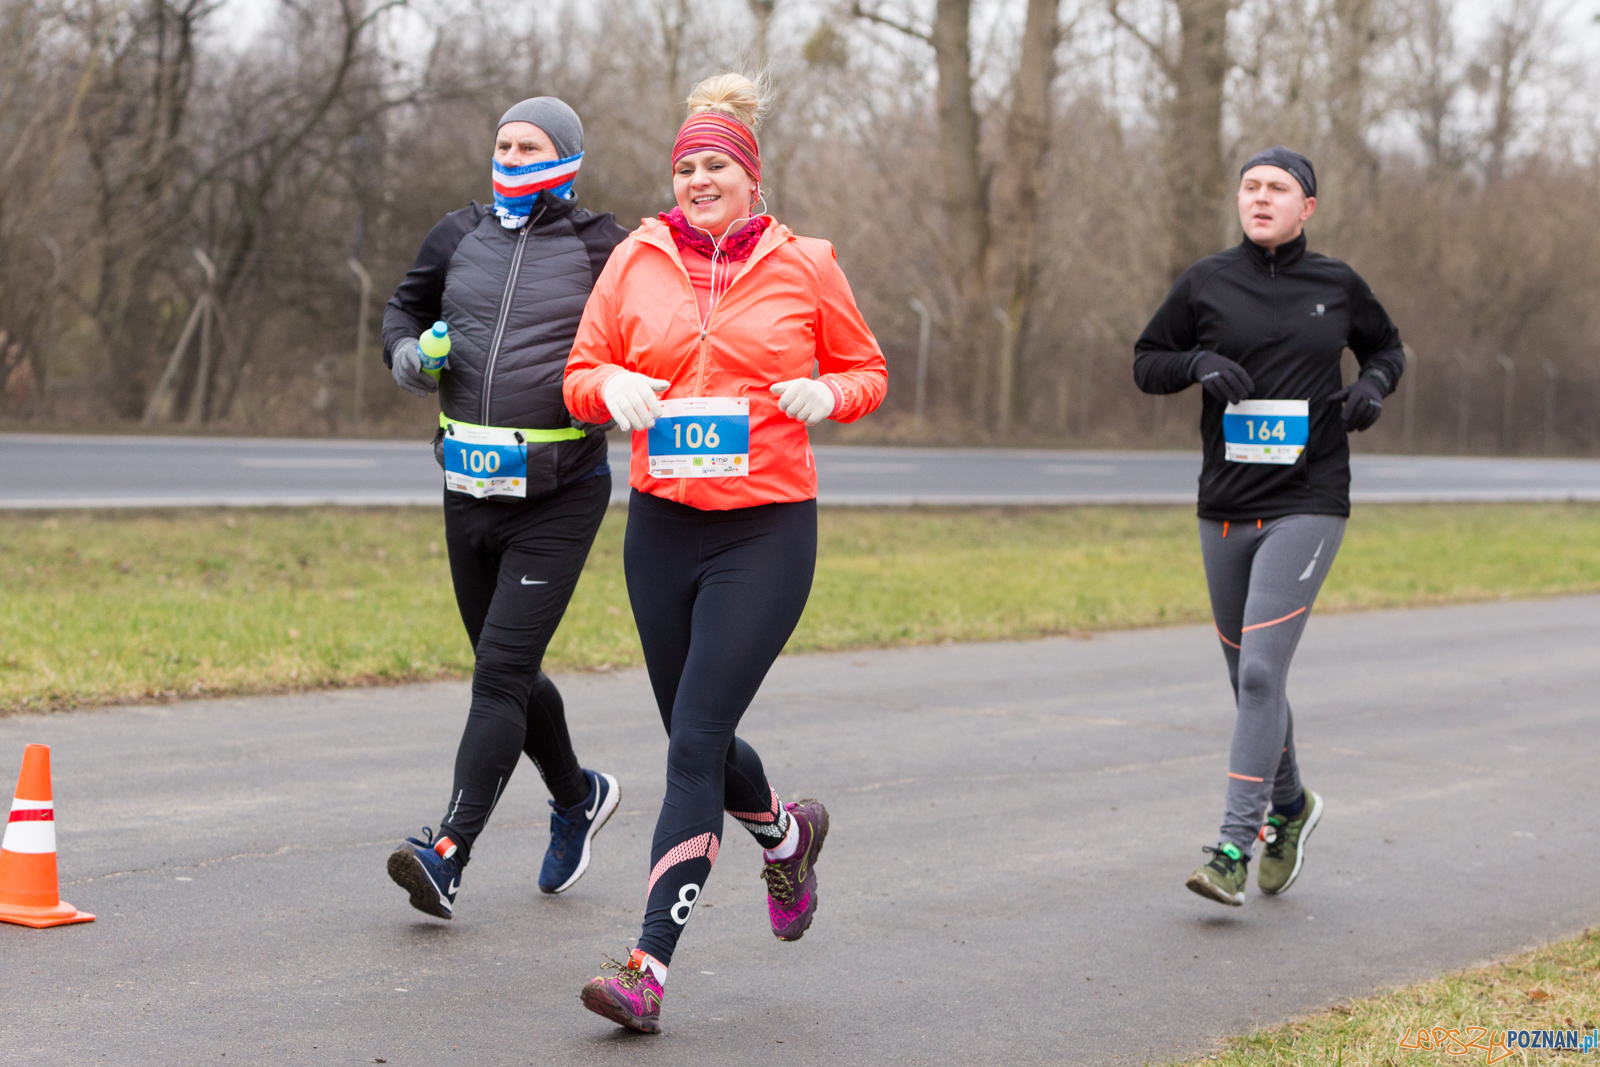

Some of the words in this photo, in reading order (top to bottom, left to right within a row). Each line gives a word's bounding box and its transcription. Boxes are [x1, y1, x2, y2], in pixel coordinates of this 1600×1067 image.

[673, 422, 720, 449] 106
[1246, 419, 1286, 441] 164
[460, 448, 501, 473] 100
[670, 883, 700, 925] 8
